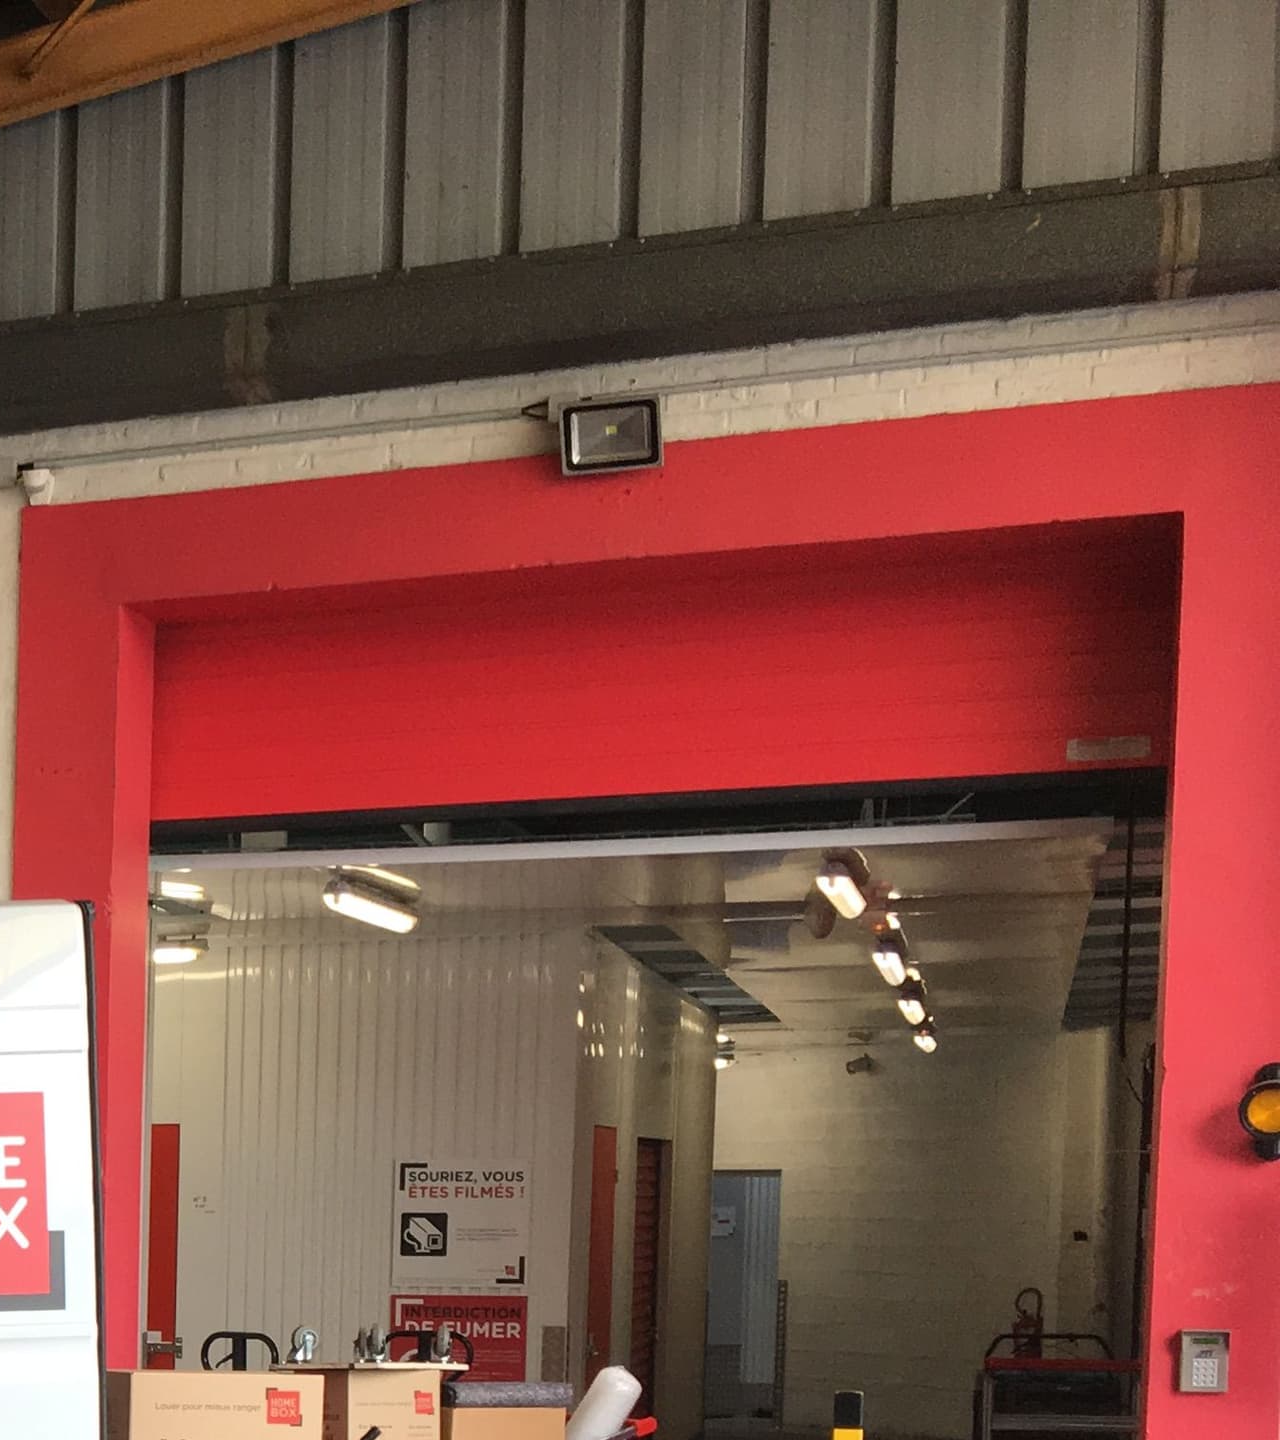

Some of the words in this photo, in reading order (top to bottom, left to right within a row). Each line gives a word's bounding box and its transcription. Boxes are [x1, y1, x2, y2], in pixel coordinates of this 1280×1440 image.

[408, 1171, 478, 1184] SOURIEZ,
[483, 1170, 525, 1183] VOUS
[408, 1183, 449, 1199] ÊTES
[454, 1183, 515, 1199] FILMÉS
[404, 1305, 522, 1319] INTERDICTION
[270, 1397, 297, 1408] HOME
[270, 1407, 298, 1418] BOX
